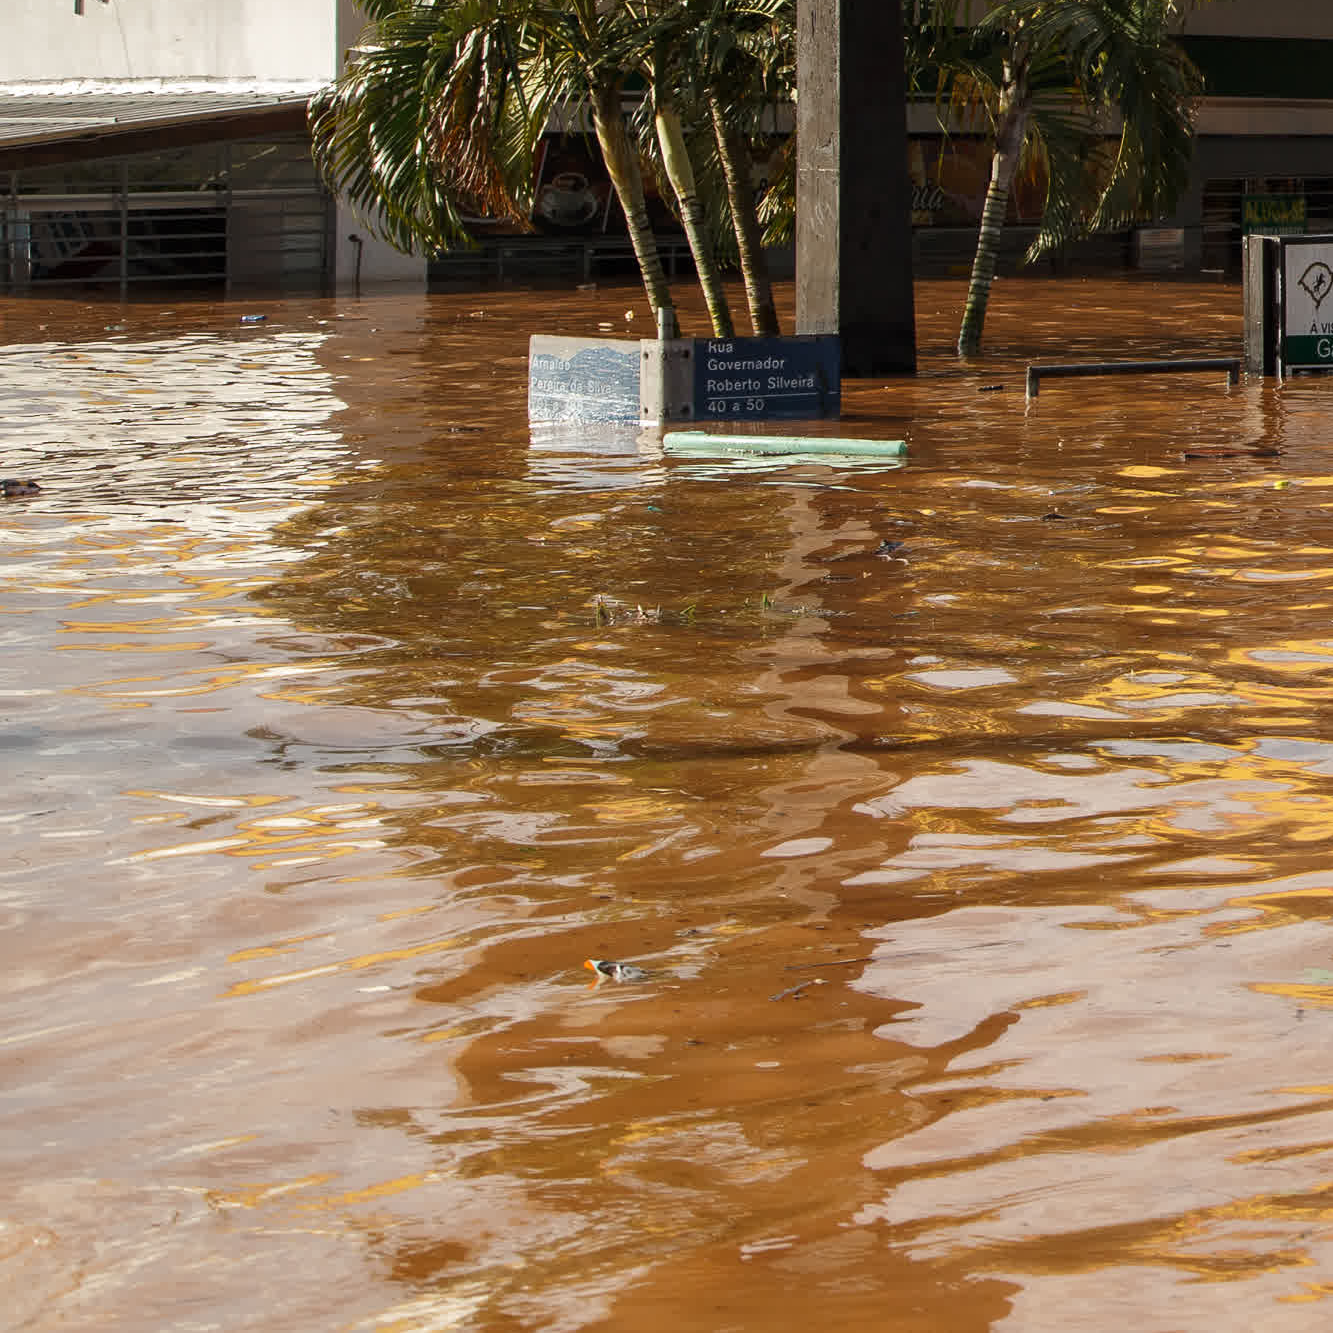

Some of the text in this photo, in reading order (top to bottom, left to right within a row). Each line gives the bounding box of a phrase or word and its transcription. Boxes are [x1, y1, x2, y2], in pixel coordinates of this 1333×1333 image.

[708, 341, 734, 353] Rua
[532, 355, 571, 371] Arnaldo
[707, 357, 785, 371] Governador
[531, 377, 568, 394] Pereira
[707, 375, 815, 392] Roberto Silveira
[708, 399, 765, 412] 40 a 50
